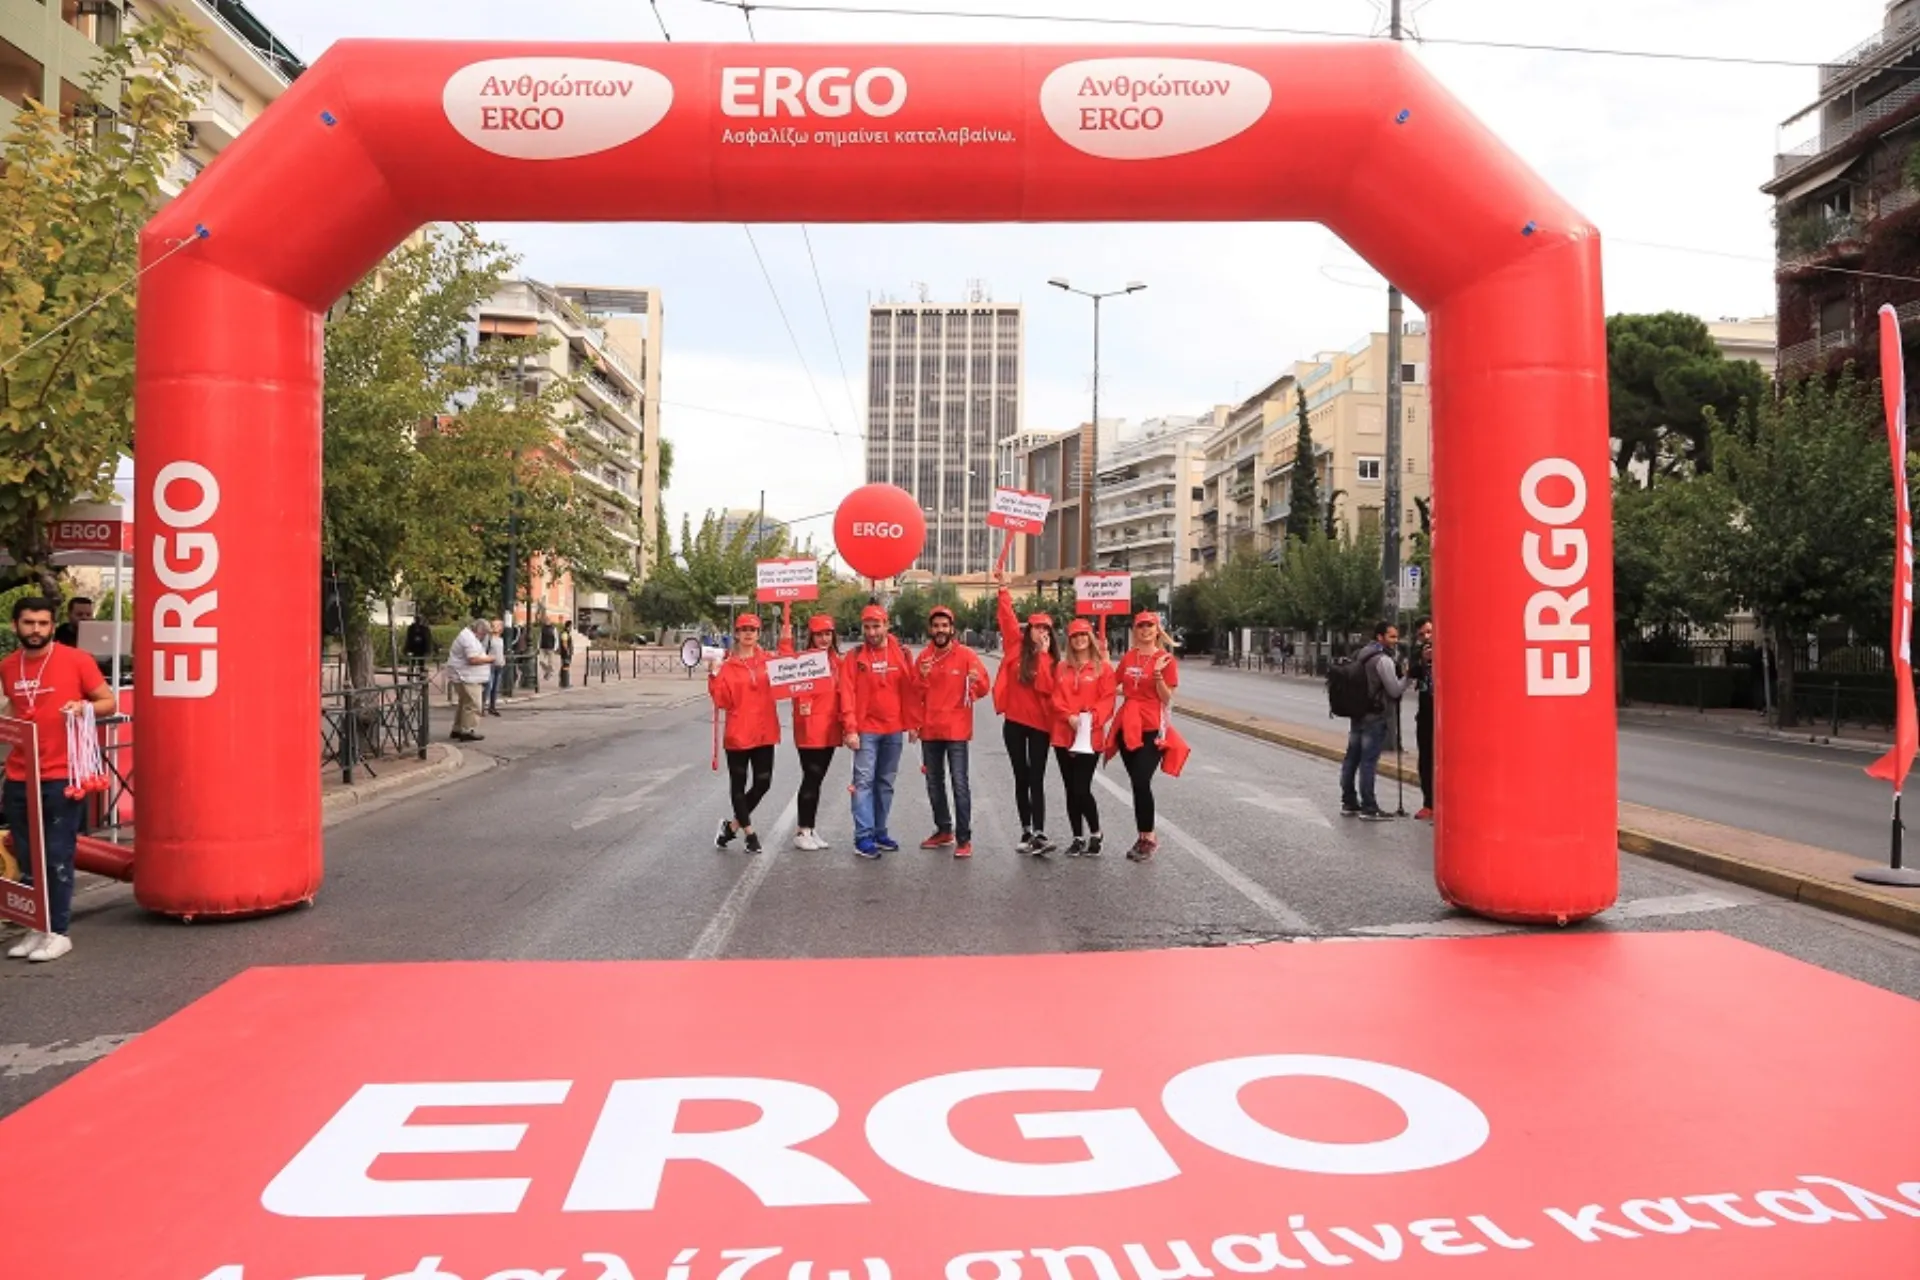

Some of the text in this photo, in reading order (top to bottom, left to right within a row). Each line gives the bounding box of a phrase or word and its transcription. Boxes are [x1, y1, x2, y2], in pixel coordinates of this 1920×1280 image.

[479, 73, 634, 103] Ανθρώπων
[720, 67, 909, 118] ERGO
[1077, 73, 1232, 103] Ανθρώπων
[481, 106, 565, 131] ERGO
[1079, 106, 1164, 132] ERGO
[722, 126, 1016, 147] Ασφαλίζω σημαίνει καταλαβαίνω.
[60, 523, 111, 540] ERGO
[852, 521, 904, 539] ERGO
[153, 461, 221, 699] ERGO
[1520, 457, 1592, 697] ERGO
[262, 1054, 1491, 1217] ERGO
[1543, 1174, 1920, 1244] καταλ
